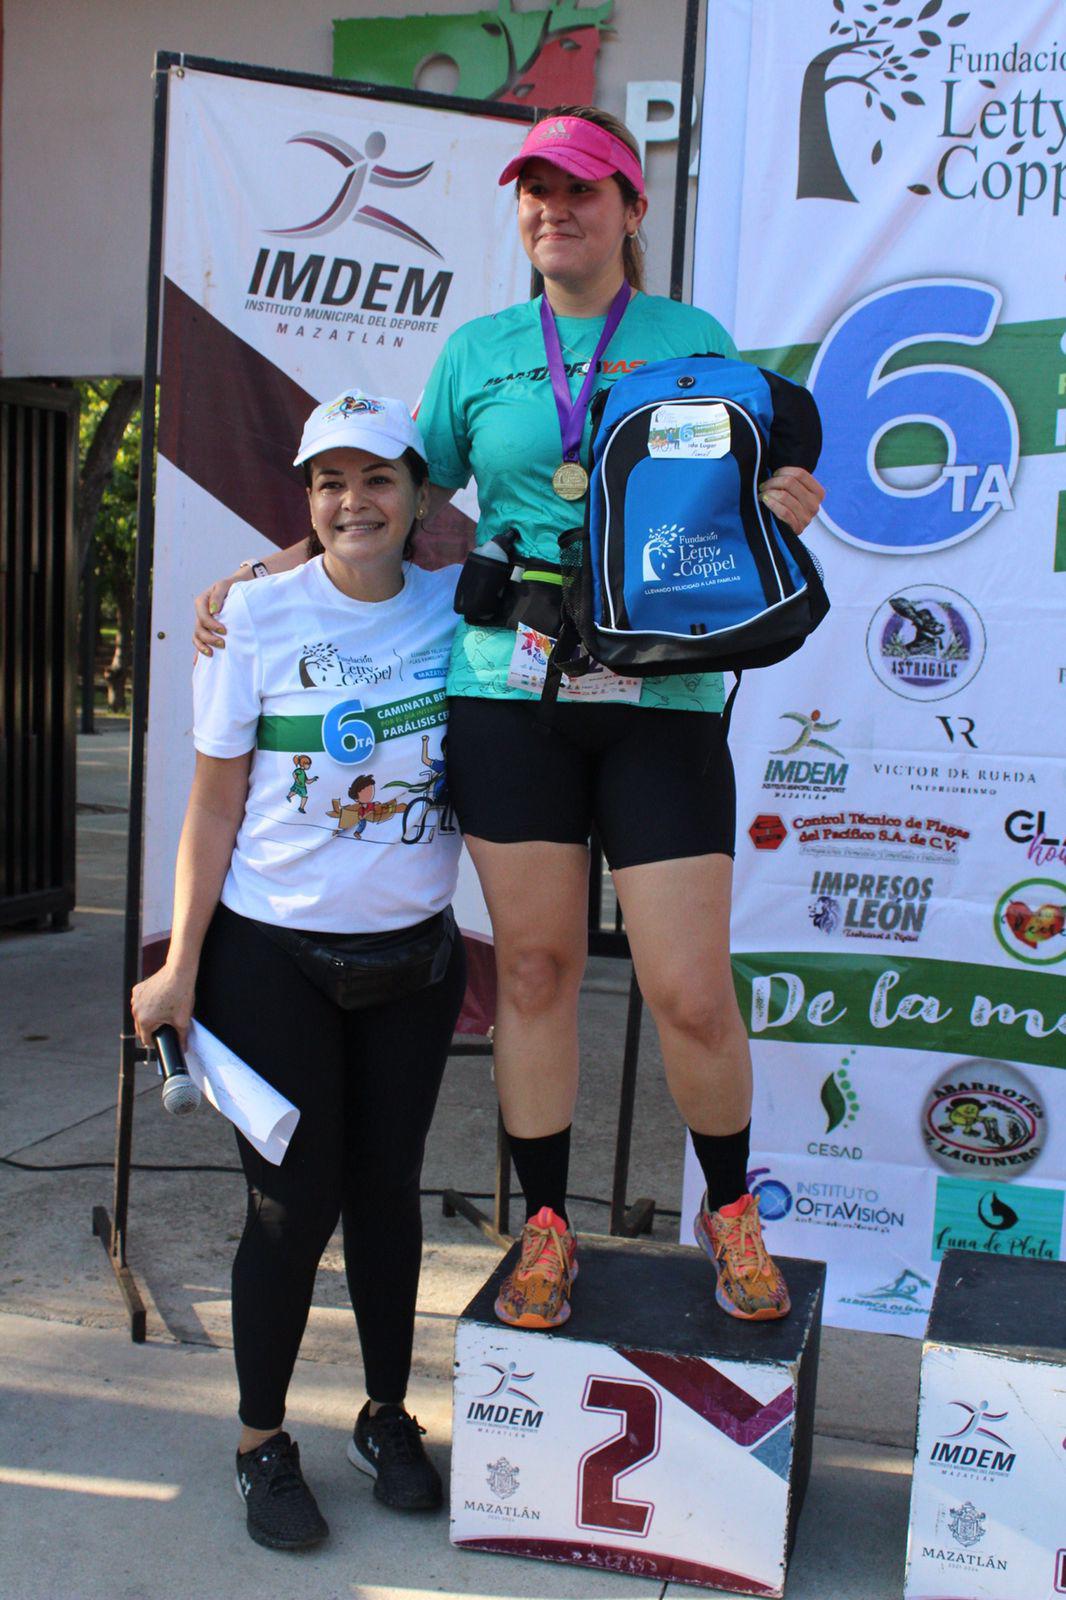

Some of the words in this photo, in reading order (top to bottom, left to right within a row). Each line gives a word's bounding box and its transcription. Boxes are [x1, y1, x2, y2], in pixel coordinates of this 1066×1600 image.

[247, 247, 454, 319] IMDEM
[244, 299, 302, 317] INSTITUTO
[304, 308, 364, 325] MUNICIPAL
[367, 316, 387, 328] DEL
[389, 318, 438, 333] DEPORTE
[276, 322, 404, 348] MAZATLÁN
[678, 531, 718, 545] Fundación
[678, 544, 716, 563] Letty
[680, 554, 736, 579] Coppel
[717, 575, 741, 585] FAMILIAS
[377, 696, 433, 719] CAMINATA
[383, 714, 437, 739] PARÁLISIS
[935, 715, 979, 749] VR
[763, 759, 849, 786] IMDEM
[873, 763, 940, 778] VICTOR
[948, 767, 970, 780] DE
[977, 769, 1037, 784] RUEDA
[792, 813, 844, 830] Control
[849, 812, 902, 827] Técnico
[905, 816, 923, 829] de
[1004, 809, 1066, 846] GL
[799, 829, 820, 843] del
[823, 828, 876, 840] Pacífico
[910, 833, 926, 846] de
[810, 870, 934, 902] IMPRESOS
[843, 897, 928, 932] LEÓN
[750, 971, 847, 1033] De
[868, 970, 953, 1030] la
[969, 994, 1066, 1039] m
[932, 1081, 1044, 1119] ABARROTES
[807, 1141, 863, 1160] CESAD
[935, 1144, 1041, 1168] LAGUNERO
[796, 1182, 879, 1204] INSTITUTO
[936, 1225, 977, 1252] Luna
[980, 1232, 1001, 1255] de
[1009, 1233, 1055, 1260] Plata
[467, 1402, 545, 1429] IMDEM
[575, 1374, 662, 1538] 2
[930, 1442, 1017, 1473] IMDEM
[464, 1500, 542, 1520] MAZATLÁN
[922, 1547, 1008, 1571] MAZATLÁN
